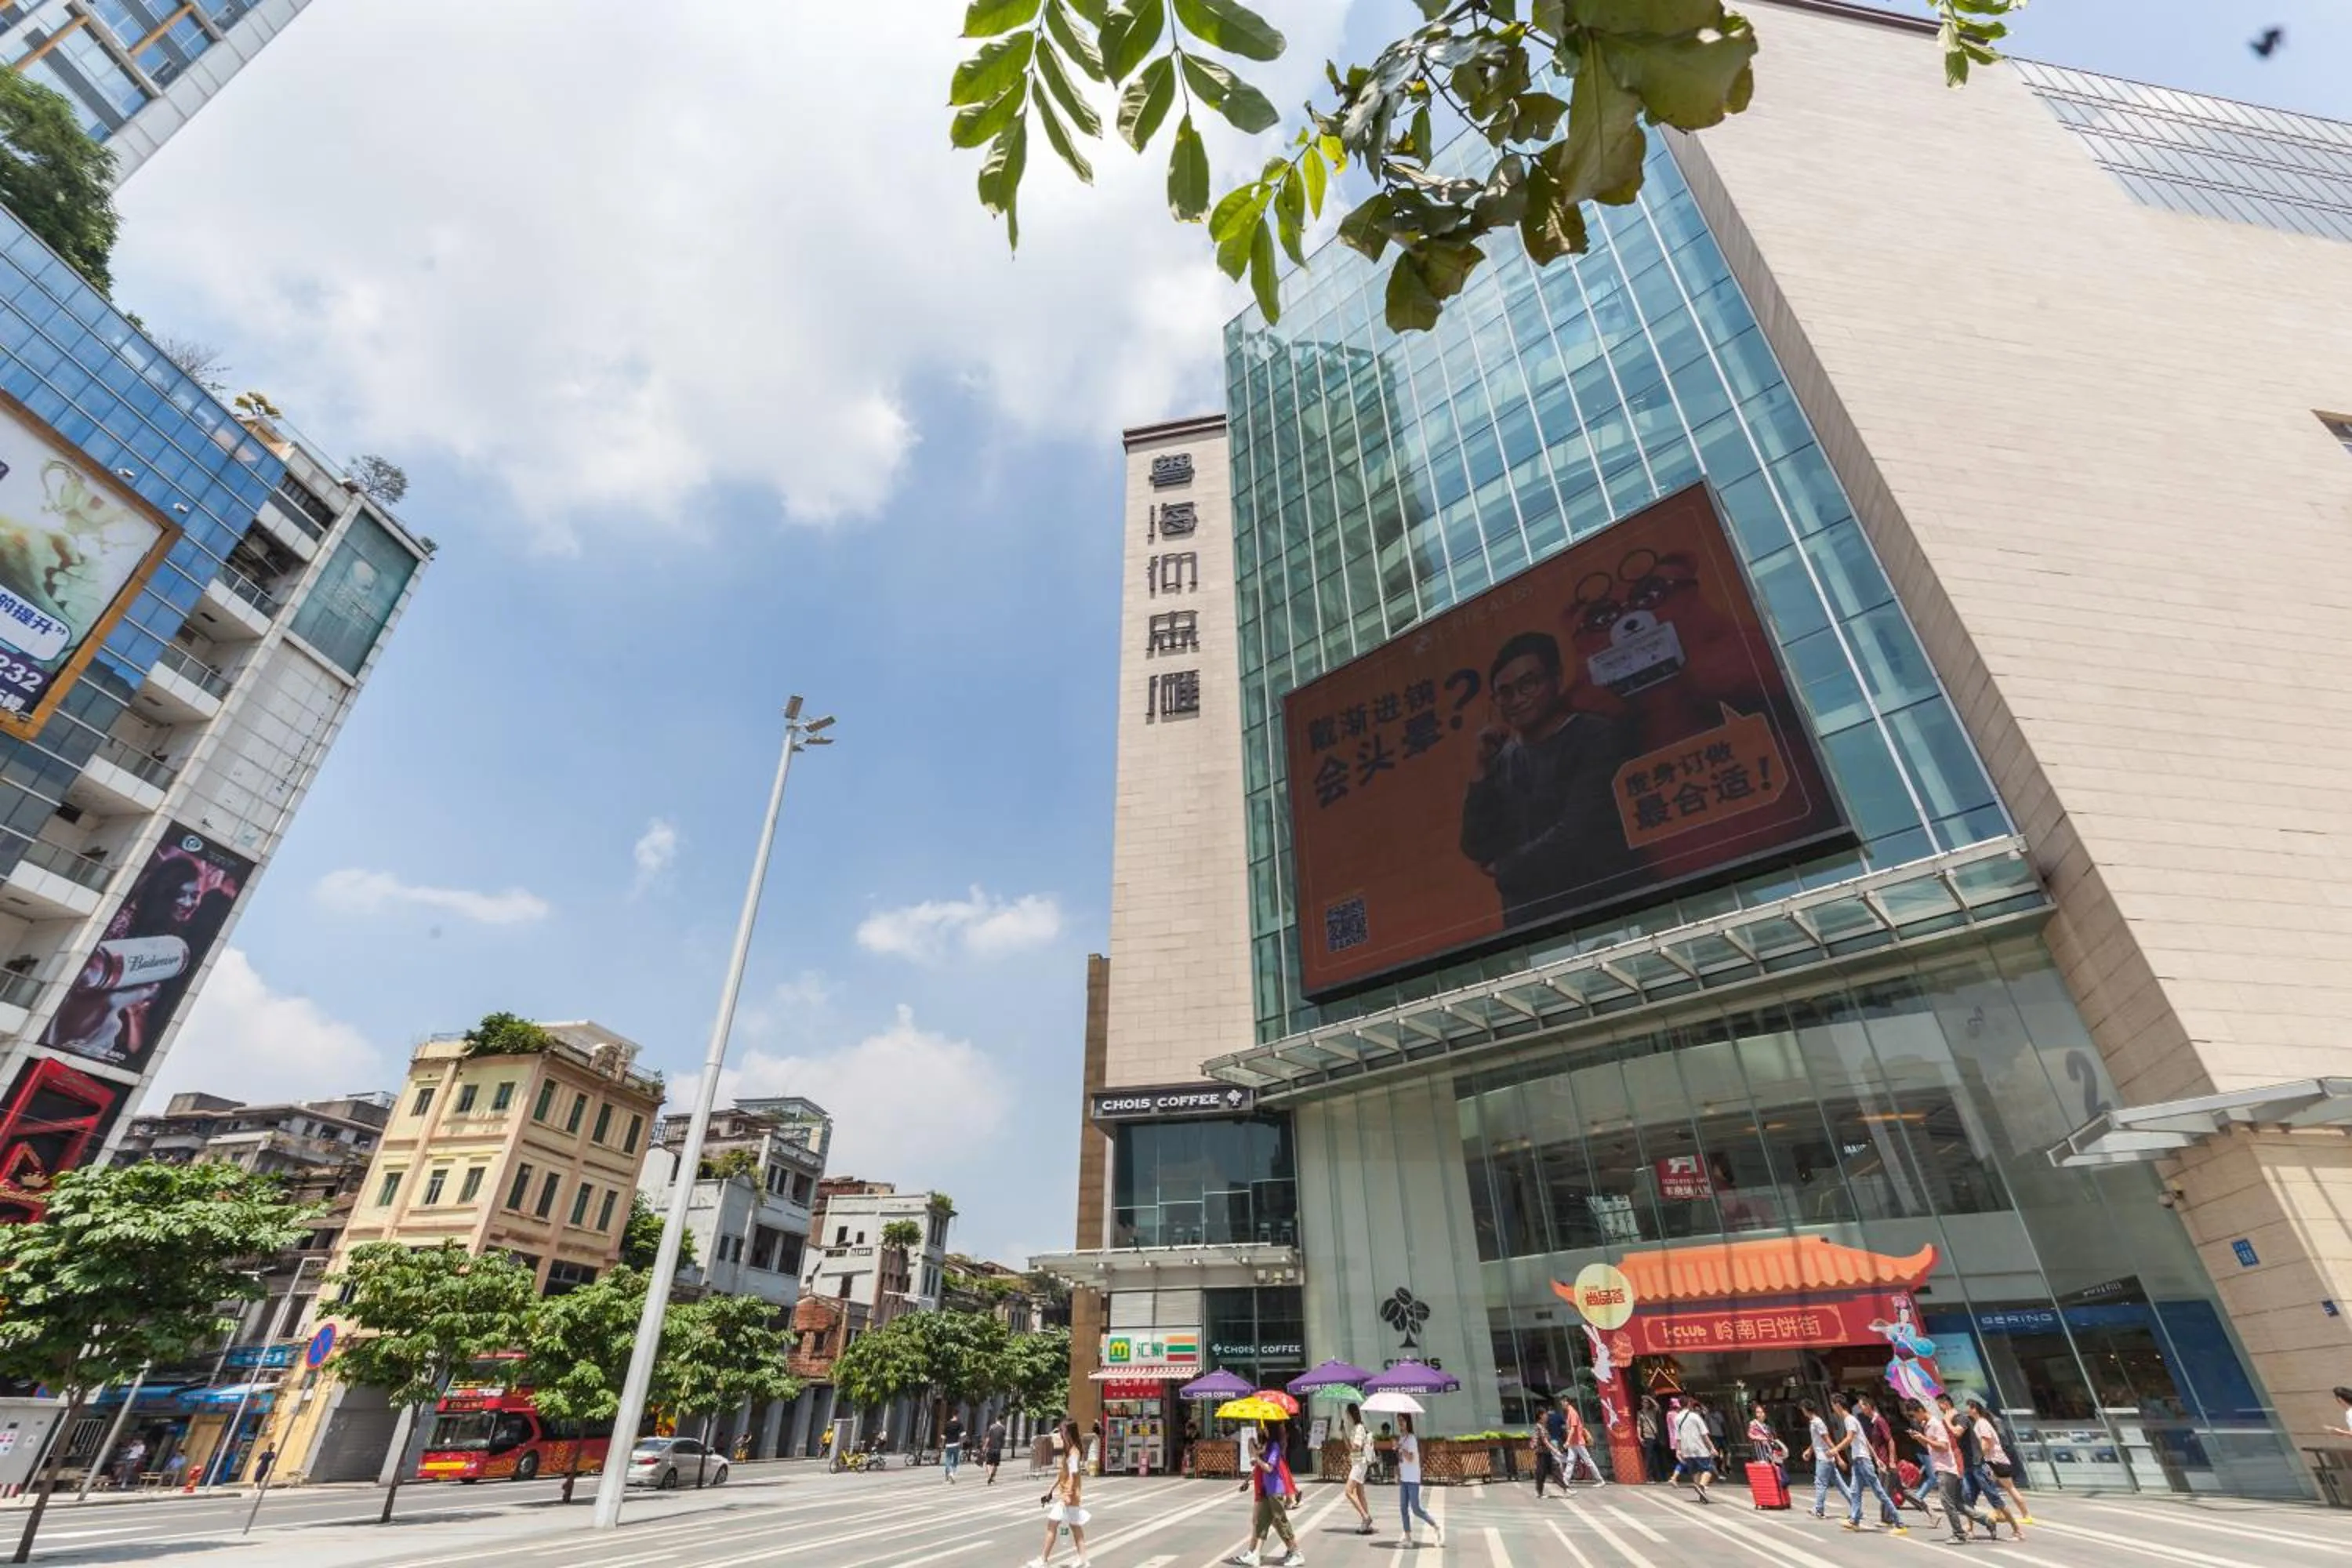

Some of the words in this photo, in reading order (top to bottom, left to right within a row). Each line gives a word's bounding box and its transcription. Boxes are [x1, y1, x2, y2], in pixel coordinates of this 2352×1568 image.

[1102, 1098, 1151, 1110] CHOIS
[1157, 1094, 1220, 1108] COFFEE
[1713, 1316, 1822, 1341] 岭南月饼街
[1224, 1345, 1255, 1354] CHOIS
[1261, 1345, 1301, 1354] COFFEE
